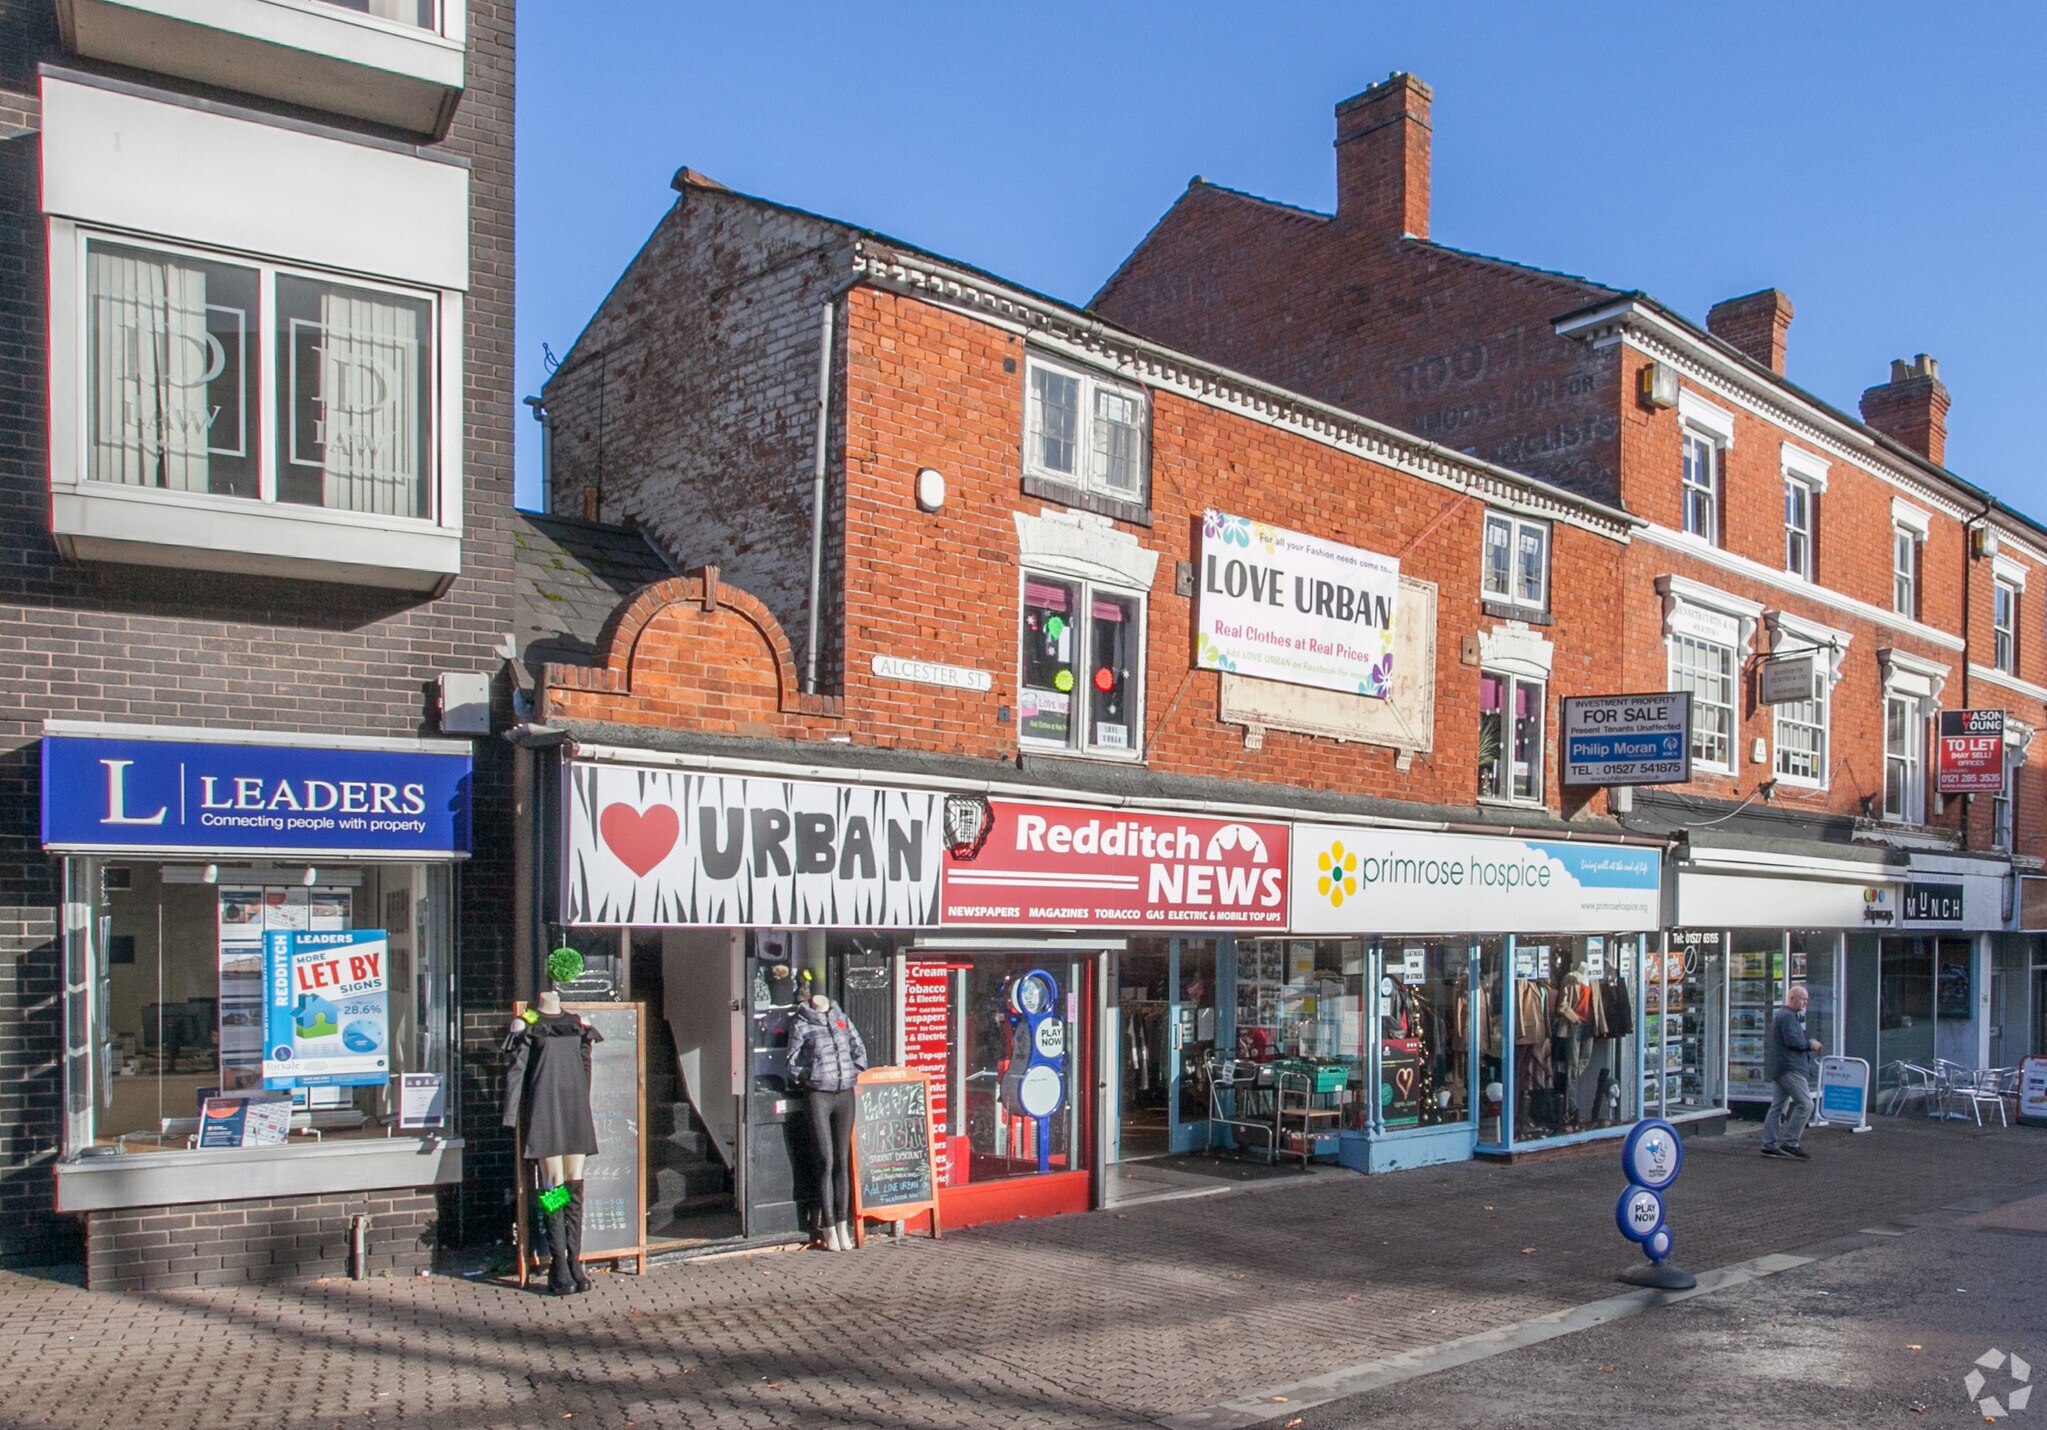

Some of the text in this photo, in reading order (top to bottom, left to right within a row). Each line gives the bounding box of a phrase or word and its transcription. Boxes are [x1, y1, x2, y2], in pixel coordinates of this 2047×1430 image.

[313, 419, 394, 457] LAW
[1259, 532, 1273, 544] For
[1275, 536, 1285, 547] all
[1286, 540, 1304, 553] your
[1306, 545, 1334, 561] Fashion
[1336, 551, 1357, 566] needs
[1359, 560, 1378, 571] come
[1207, 554, 1392, 630] LOVE URBAN
[1215, 619, 1370, 663] Real Clothes at Real Prices
[1225, 647, 1241, 658] Add
[1243, 650, 1262, 662] LOVE
[1264, 654, 1291, 667] URBAN
[1292, 661, 1302, 669] on
[1303, 661, 1337, 675] Facebook
[880, 659, 958, 684] ALCESTER
[1575, 696, 1677, 708] INVESTMENT PROPERTY
[1584, 707, 1668, 723] FOR SALE
[1962, 711, 2002, 721] MASON
[1571, 722, 1681, 734] Present Tenants Unaffected
[1962, 721, 2002, 730] YOUNG
[1573, 742, 1657, 757] Philip Moran
[1946, 739, 1998, 751] TO LET
[1571, 765, 1592, 775] TEL
[1603, 764, 1635, 775] 01527
[1640, 762, 1681, 773] 541875
[1941, 774, 2000, 782] 0121 285 3535
[100, 760, 167, 825] L
[201, 776, 426, 815] LEADERS
[202, 813, 426, 833] Connecting people with property
[1016, 815, 1199, 859] Redditch
[699, 807, 923, 882] URBAN
[1362, 851, 1550, 893] primrose hospice
[1148, 863, 1282, 907] NEWS
[1580, 900, 1648, 914] www.primrosehospice.org
[1907, 892, 1960, 918] MUNCH
[948, 906, 1281, 922] NEWSPAPERS MAGAZINES TOBACCO GAS ELECTRIC & MOBILE TOP UPS
[296, 934, 353, 944] LEADERS
[1673, 933, 1684, 944] Tel:
[1685, 933, 1702, 944] 01527
[296, 953, 326, 964] MORE
[274, 934, 289, 1007] REDDITCH
[297, 953, 380, 991] LET BY
[912, 966, 947, 977] Cream
[340, 979, 382, 994] SIGNS
[909, 995, 946, 1004] & Electric
[344, 1004, 382, 1015] 28.6%
[905, 1014, 946, 1024] wspapers
[917, 1033, 946, 1041] Electric
[1041, 1028, 1062, 1038] PLAY
[1041, 1038, 1062, 1047] NOW
[918, 1052, 947, 1060] Top-ups
[861, 1084, 926, 1121] LOVE
[857, 1116, 928, 1155] URBAN
[868, 1153, 894, 1164] STUDENT
[895, 1150, 924, 1161] DISCOUNT
[863, 1183, 880, 1197] Add
[884, 1181, 899, 1194] LOVE
[899, 1180, 919, 1190] URBAN
[880, 1193, 907, 1204] Facebook
[1635, 1204, 1656, 1213] PLAY
[1635, 1213, 1656, 1222] NOW
